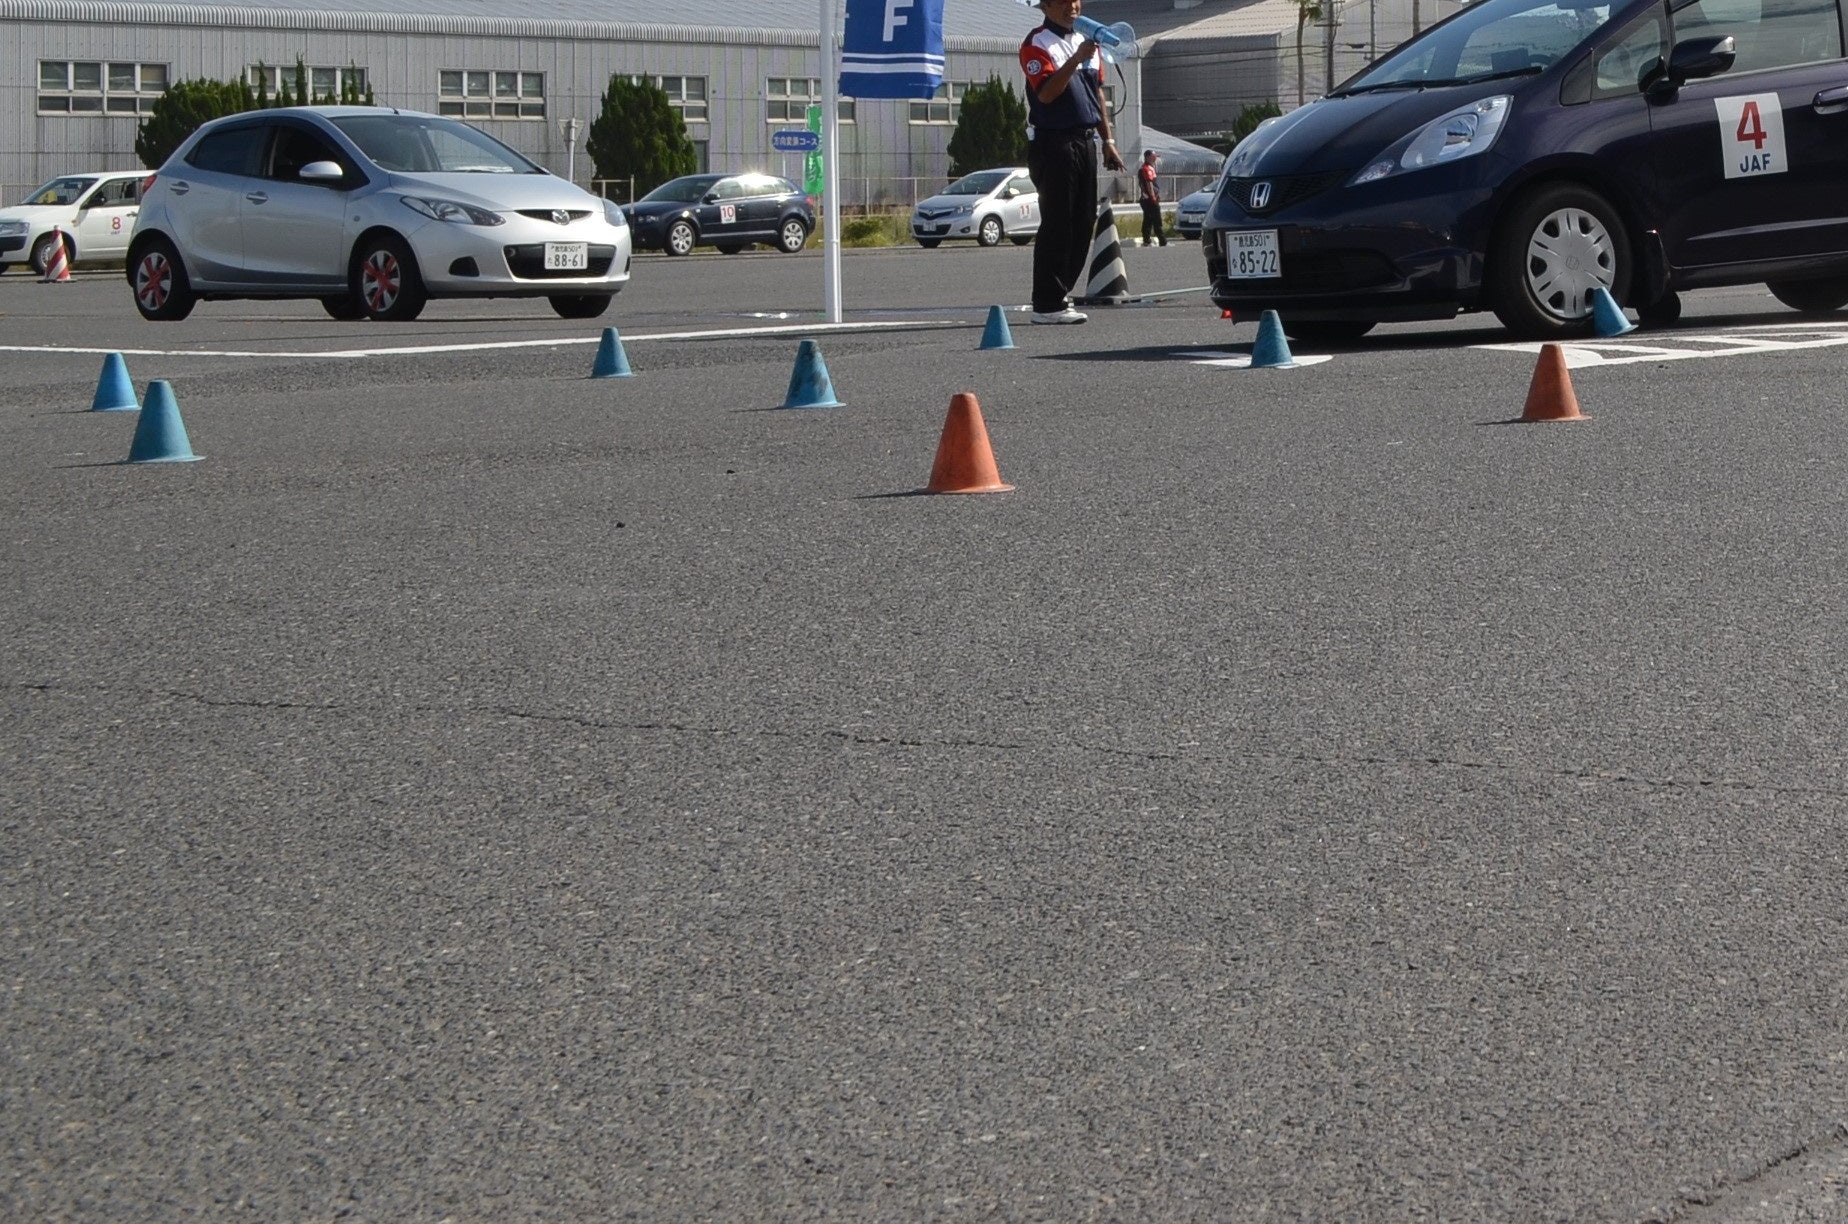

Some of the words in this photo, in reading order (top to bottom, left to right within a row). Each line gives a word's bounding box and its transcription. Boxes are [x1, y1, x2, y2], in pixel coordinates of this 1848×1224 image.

[1736, 101, 1768, 150] 4
[1740, 152, 1771, 173] JAF
[722, 206, 735, 218] 10
[112, 216, 122, 230] 8
[554, 253, 584, 267] 88-61
[1239, 249, 1277, 274] 85-22
